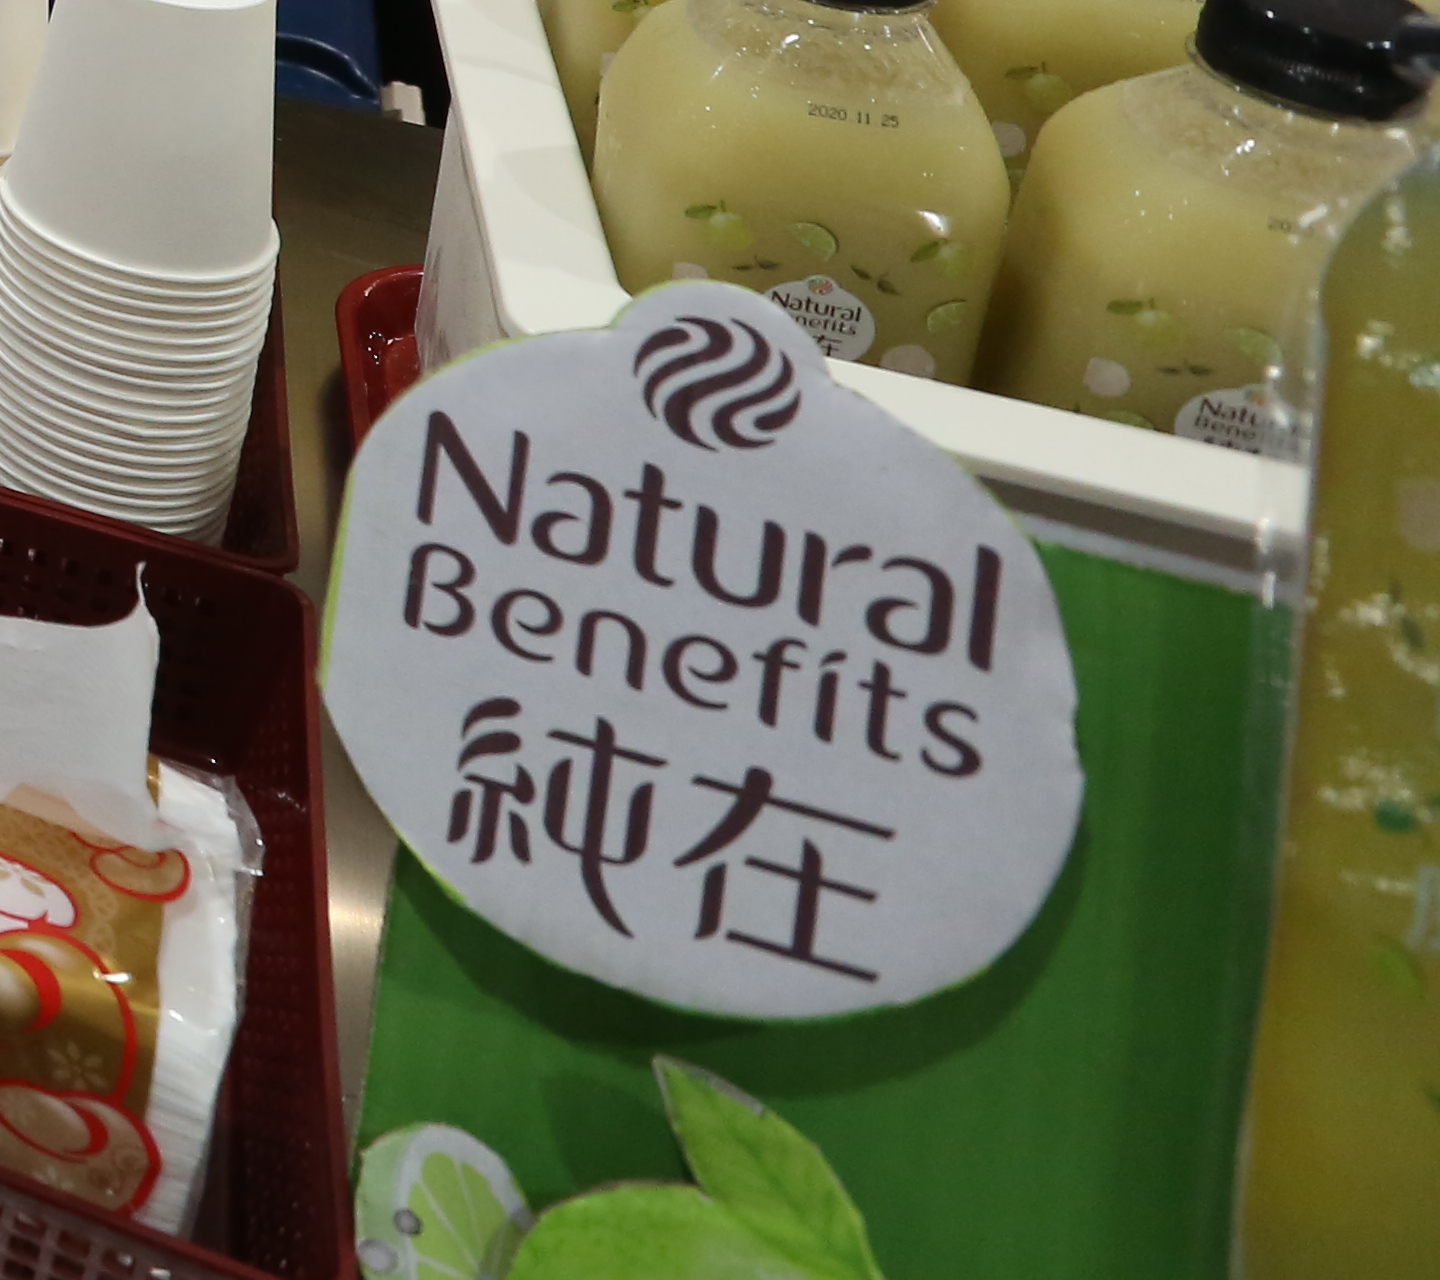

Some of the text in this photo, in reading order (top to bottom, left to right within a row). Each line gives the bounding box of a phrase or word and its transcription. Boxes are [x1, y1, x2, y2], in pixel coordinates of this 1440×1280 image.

[806, 102, 901, 130] 2020 11 25
[770, 289, 863, 324] Natural
[793, 315, 857, 337] nefits
[415, 410, 1002, 674] Natural
[403, 542, 986, 779] Benefits
[446, 696, 897, 983] 純在
